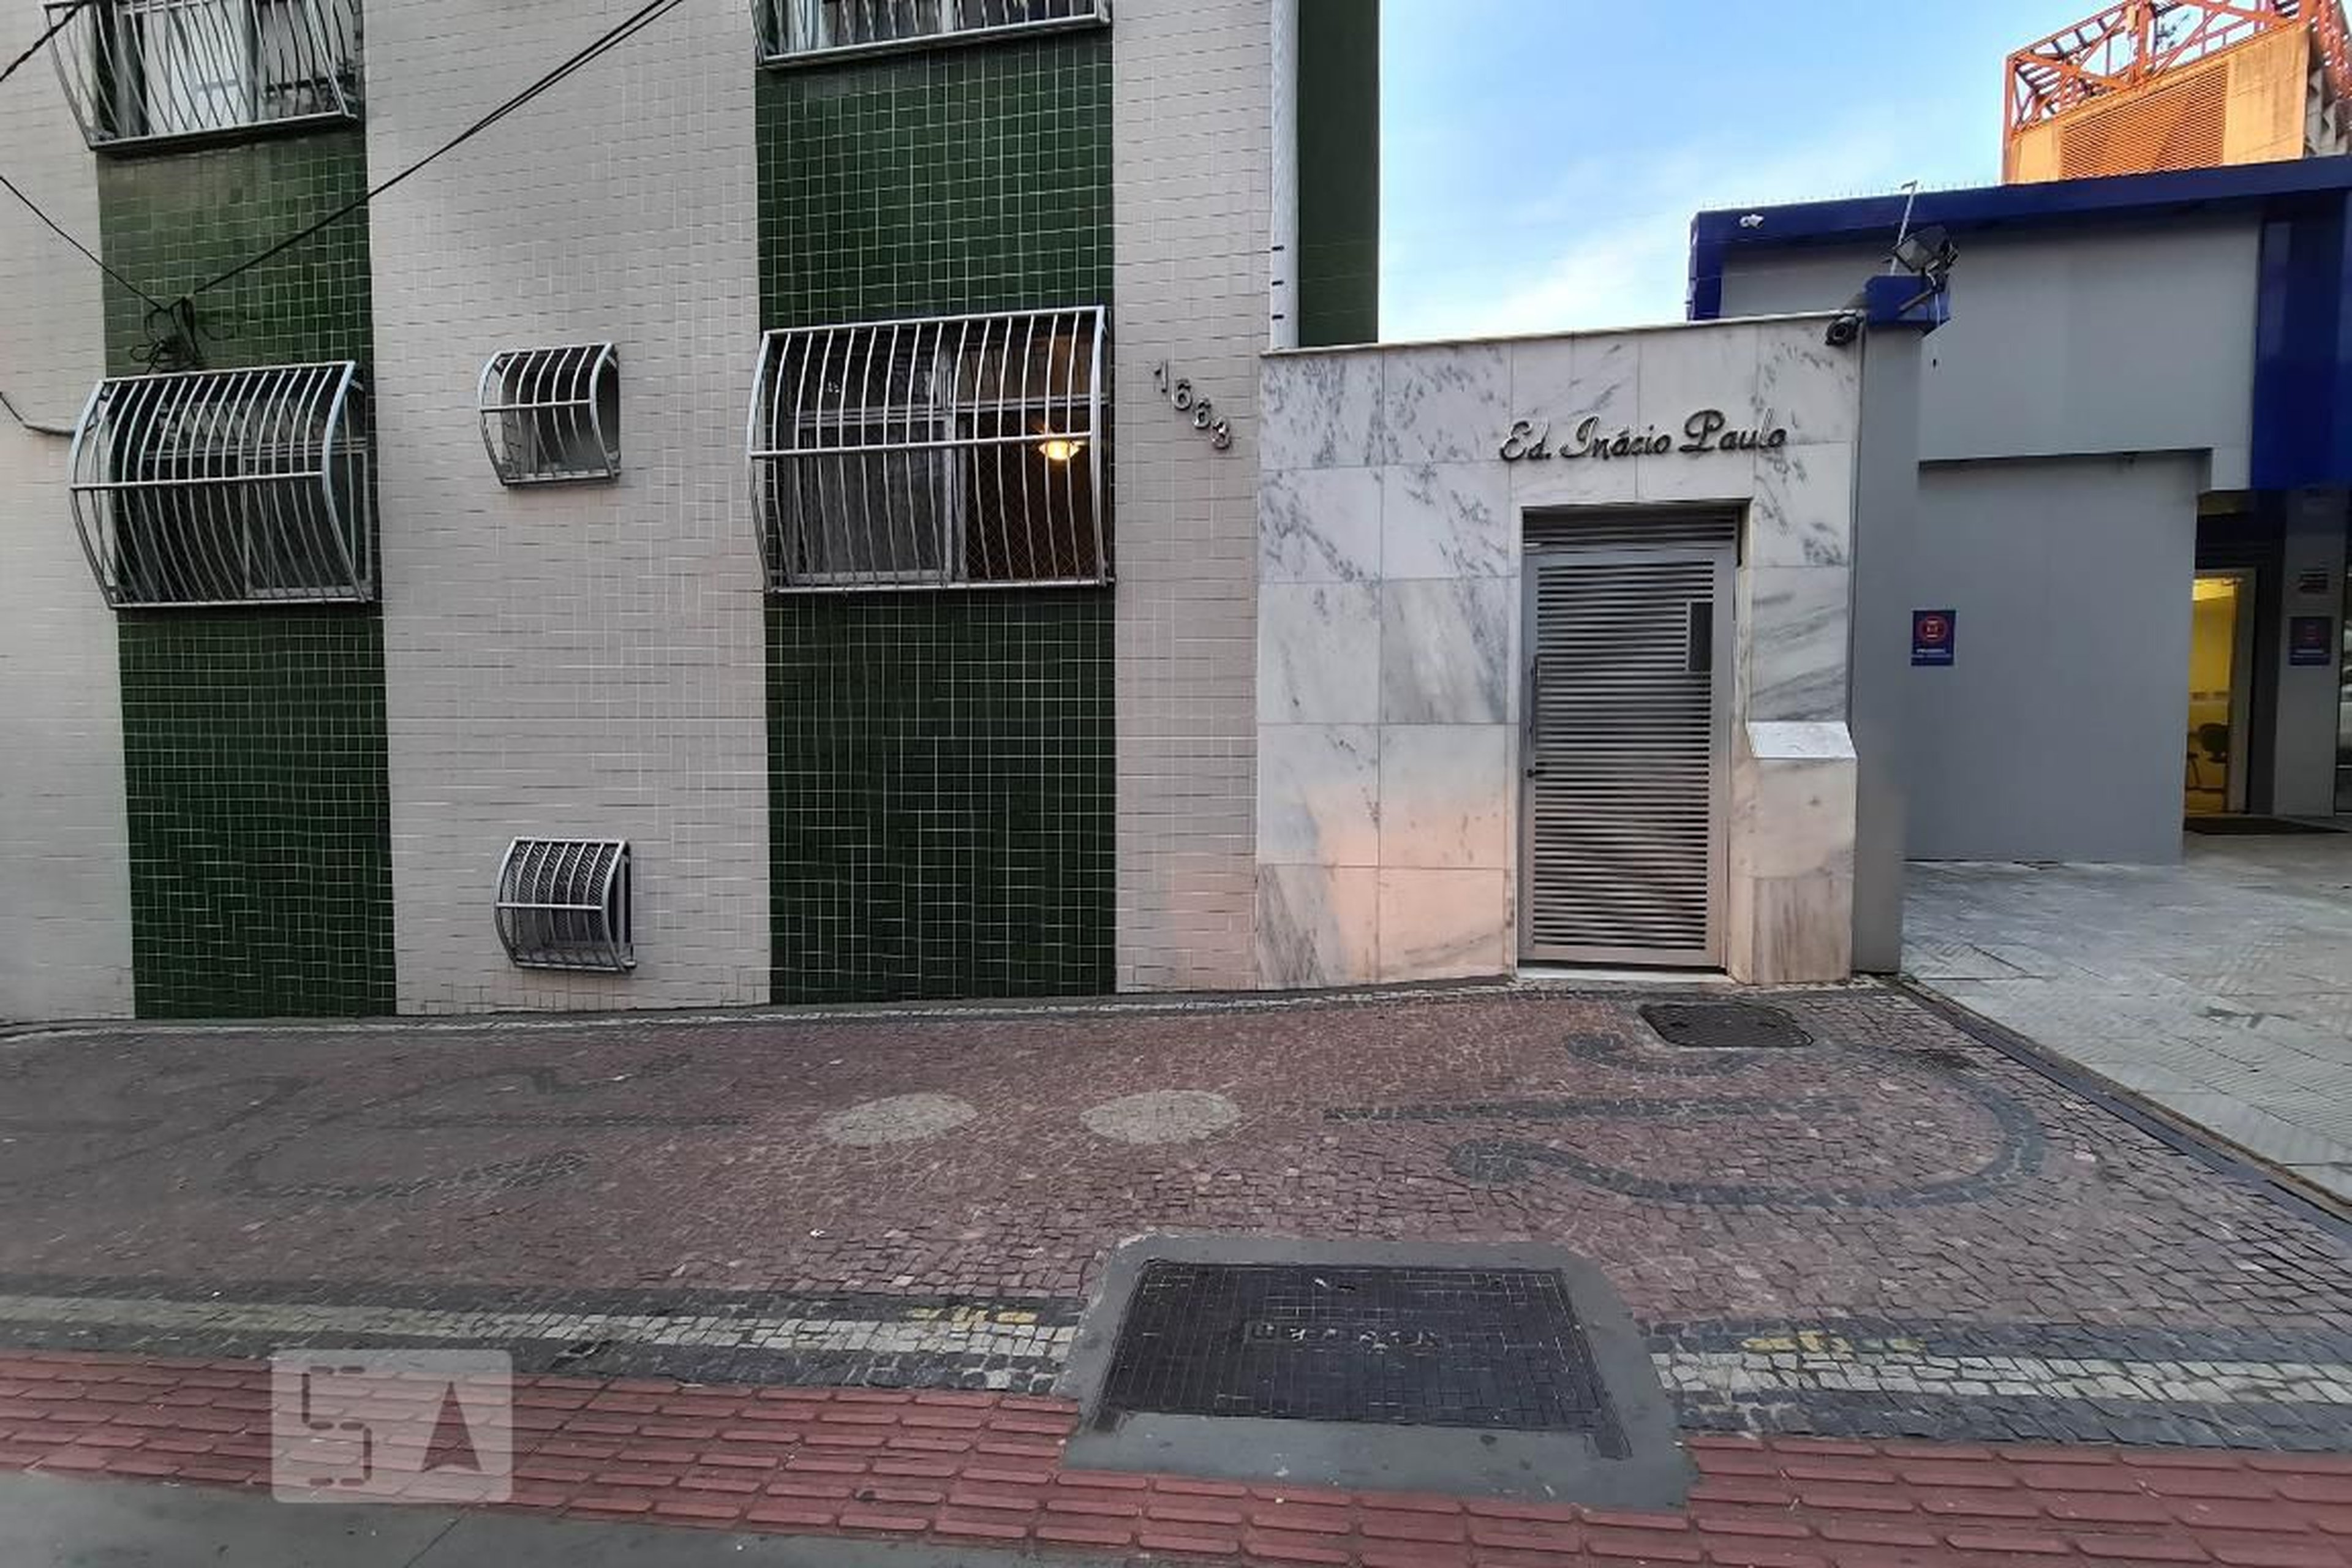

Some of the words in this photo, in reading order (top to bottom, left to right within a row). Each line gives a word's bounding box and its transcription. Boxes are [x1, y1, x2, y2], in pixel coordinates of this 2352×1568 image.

[1153, 359, 1232, 451] 1663
[1499, 417, 1551, 461] Ed.
[1559, 415, 1672, 460] Inácio
[1679, 409, 1787, 452] Paulo
